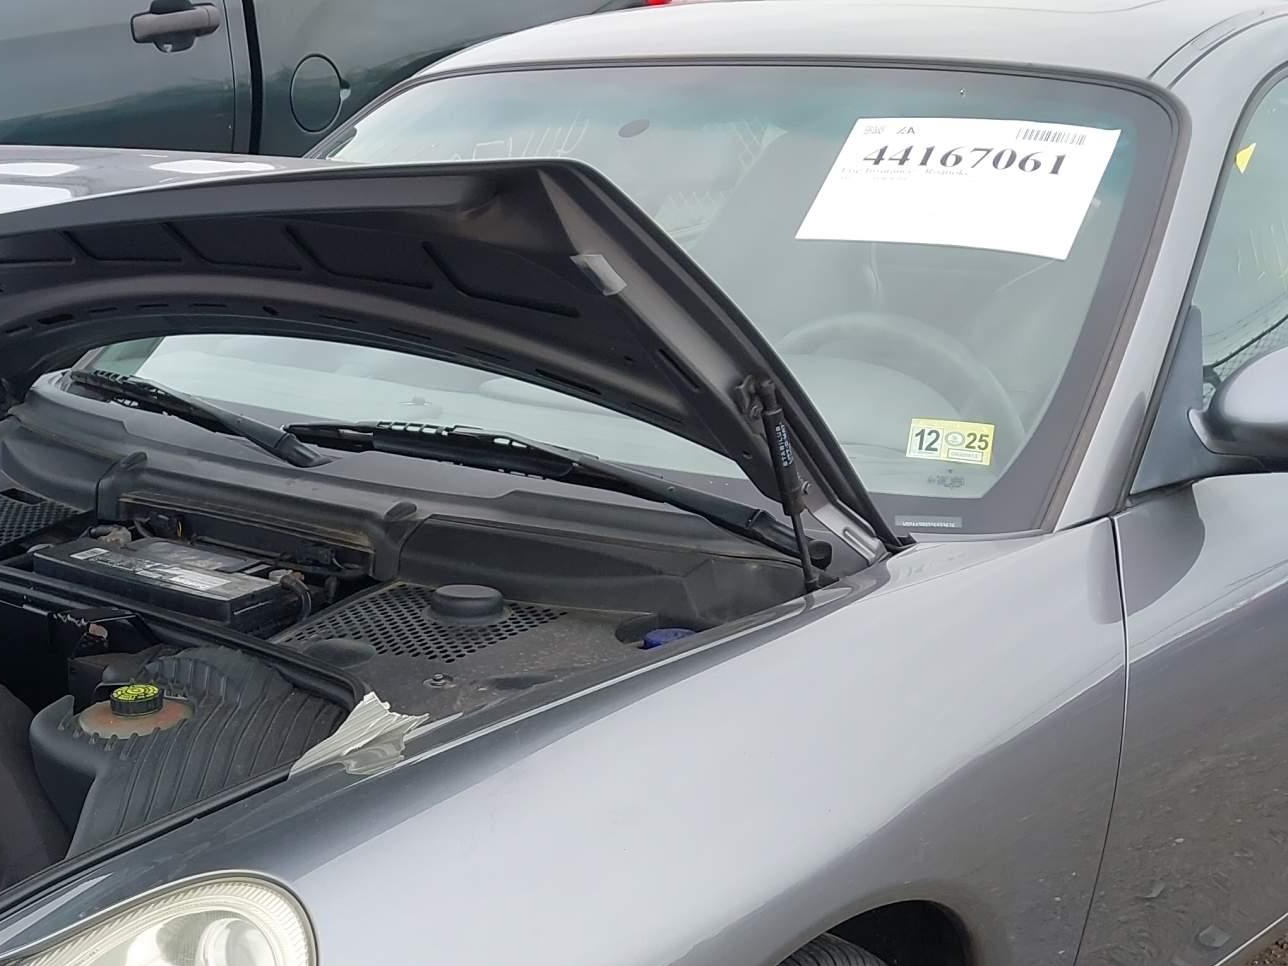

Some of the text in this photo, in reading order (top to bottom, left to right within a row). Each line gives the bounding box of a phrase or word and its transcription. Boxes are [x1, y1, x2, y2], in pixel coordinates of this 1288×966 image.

[863, 145, 1067, 176] 44167061
[914, 428, 990, 452] 12 25
